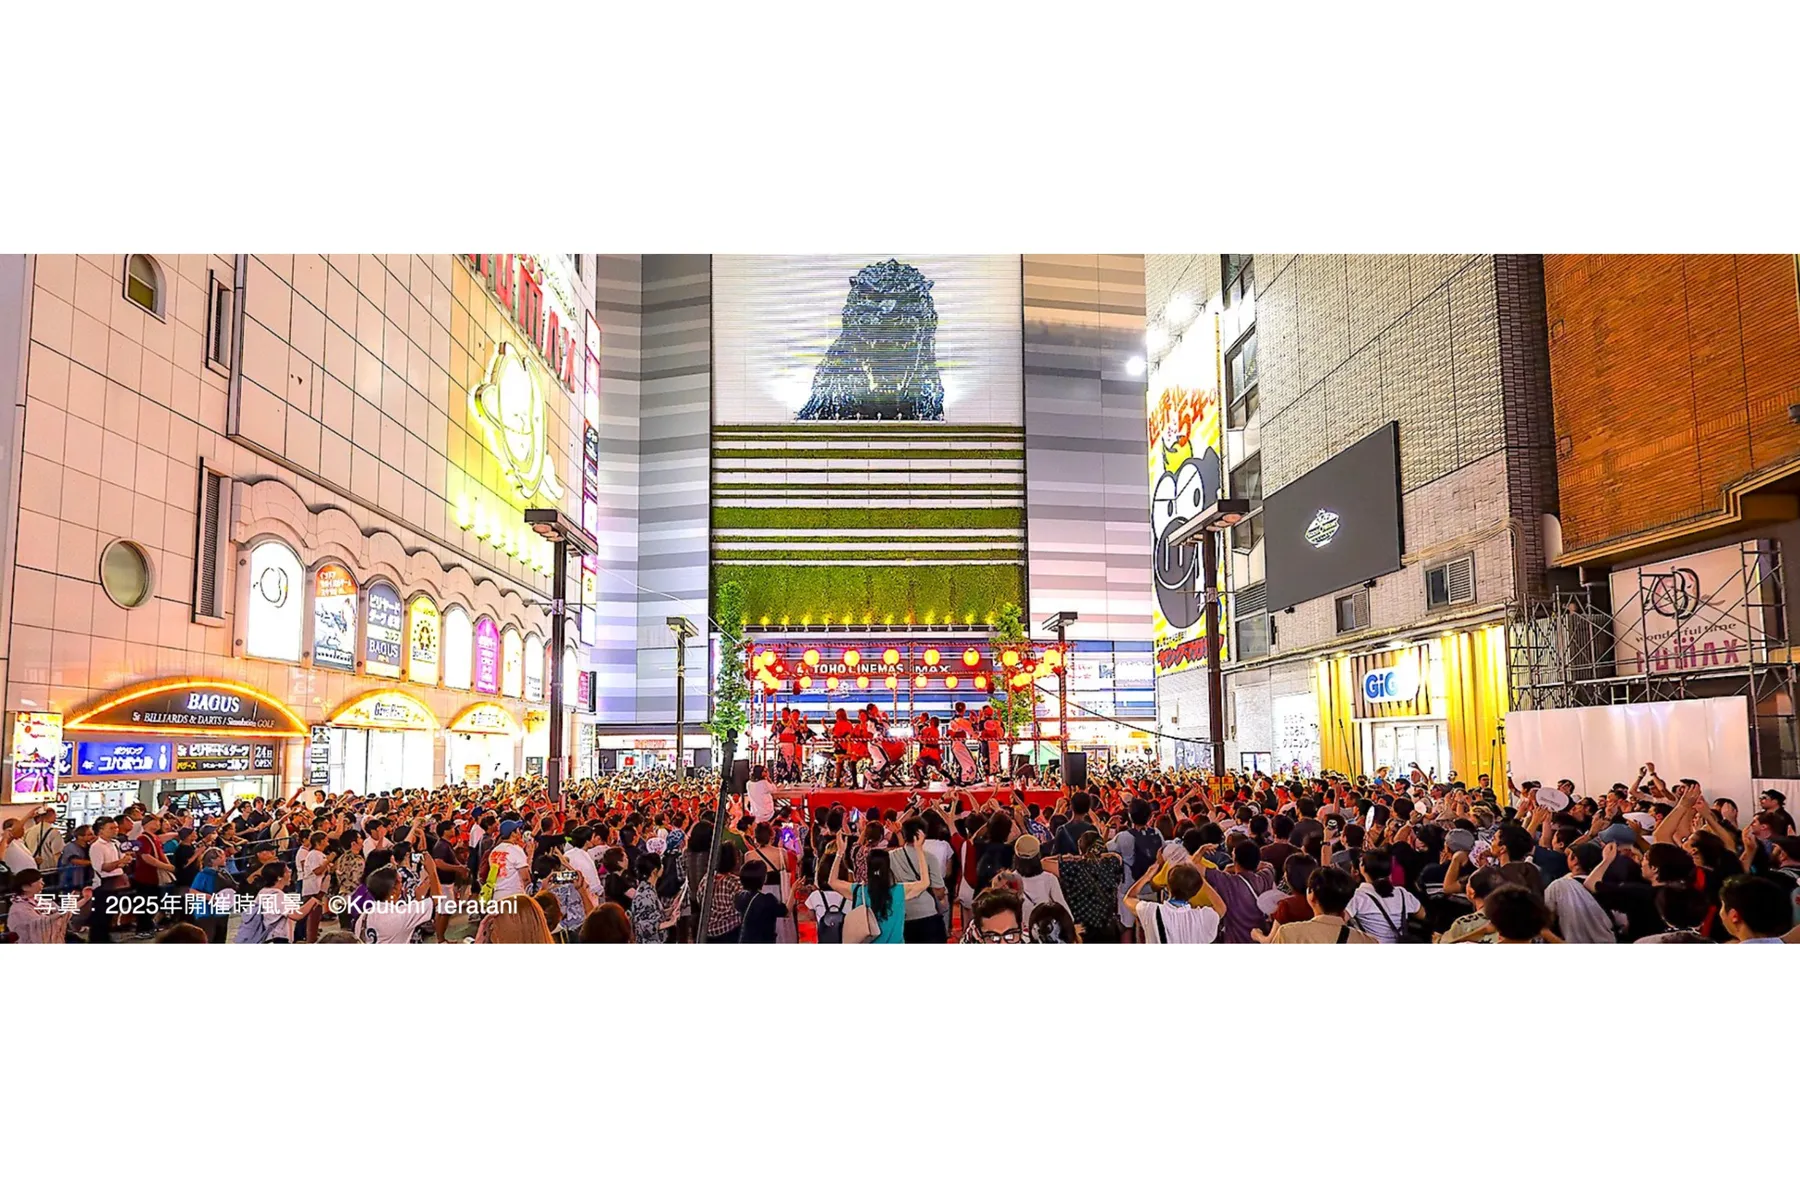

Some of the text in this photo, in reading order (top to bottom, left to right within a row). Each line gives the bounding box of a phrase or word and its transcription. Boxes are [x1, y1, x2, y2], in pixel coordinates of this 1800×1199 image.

[369, 639, 399, 658] BAGUS
[812, 664, 846, 674] TOHO
[187, 692, 241, 713] BAGUS
[144, 712, 188, 724] BILLIARDS
[188, 715, 197, 725] &
[198, 716, 223, 726] DARTS
[257, 719, 275, 728] GOLF
[254, 759, 273, 768] OPEN
